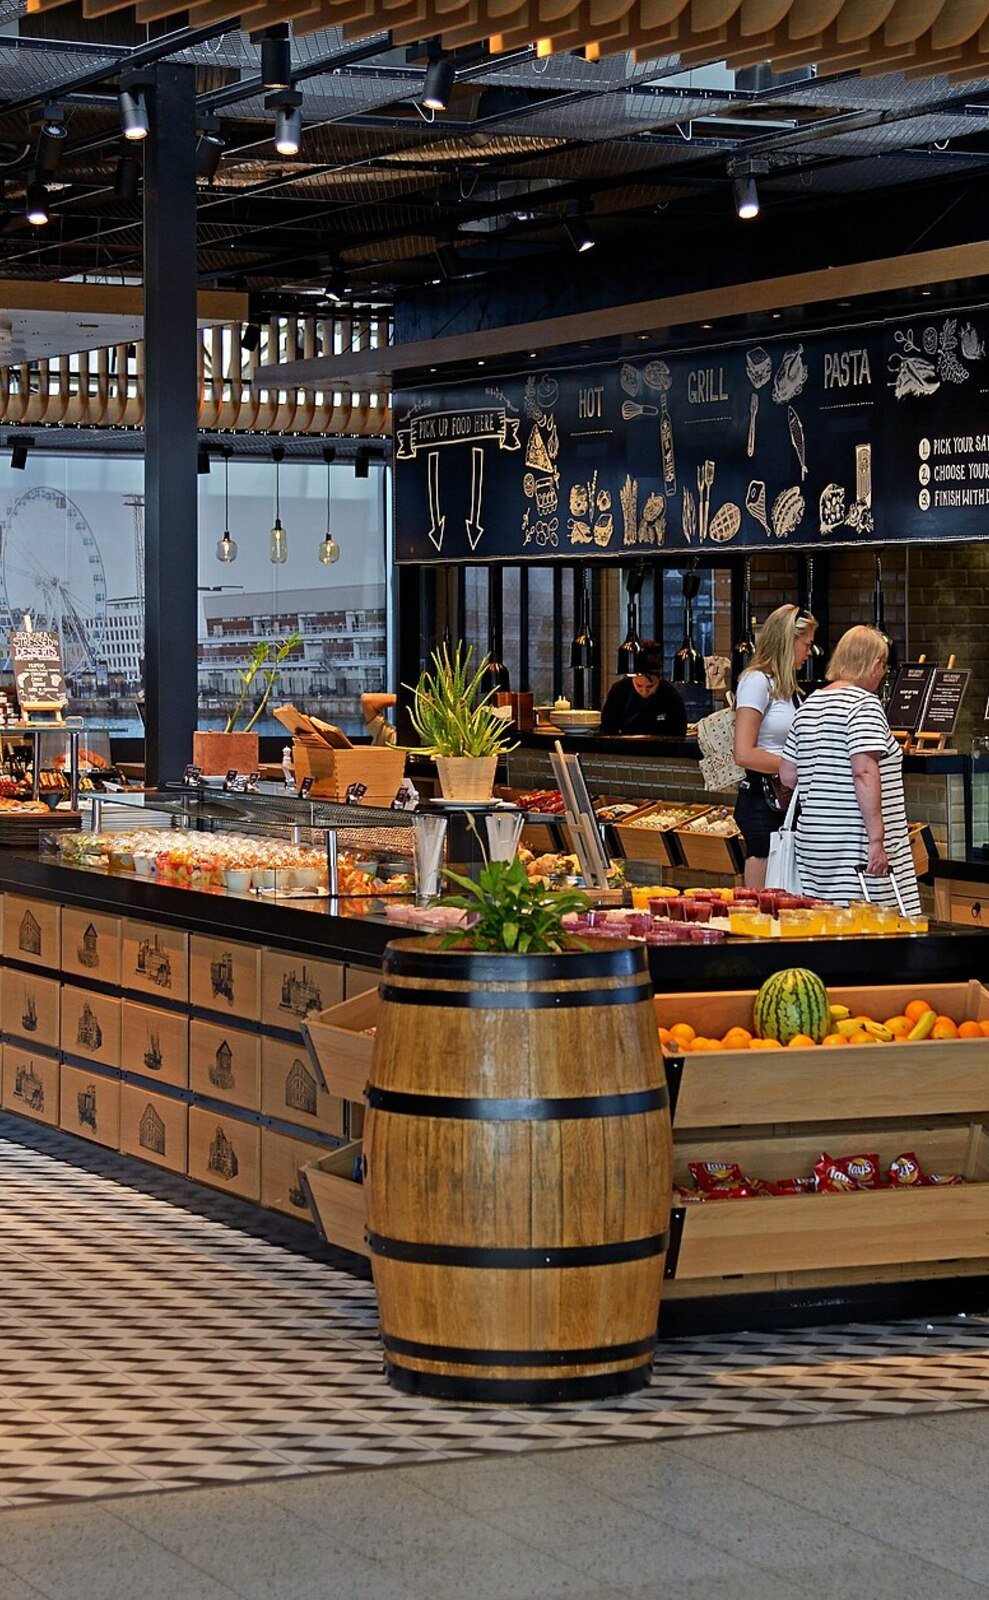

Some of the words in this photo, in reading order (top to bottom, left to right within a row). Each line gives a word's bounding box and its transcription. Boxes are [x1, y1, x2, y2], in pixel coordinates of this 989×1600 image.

[823, 349, 871, 389] PASTA
[687, 368, 729, 404] GRILL
[578, 386, 605, 419] HOT
[418, 419, 436, 439] PICK
[438, 417, 449, 436] UP
[452, 415, 472, 436] FOOD
[474, 413, 495, 433] HERE
[933, 437, 952, 455] PICK
[953, 436, 975, 454] YOUR
[933, 464, 966, 482] CHOOSE
